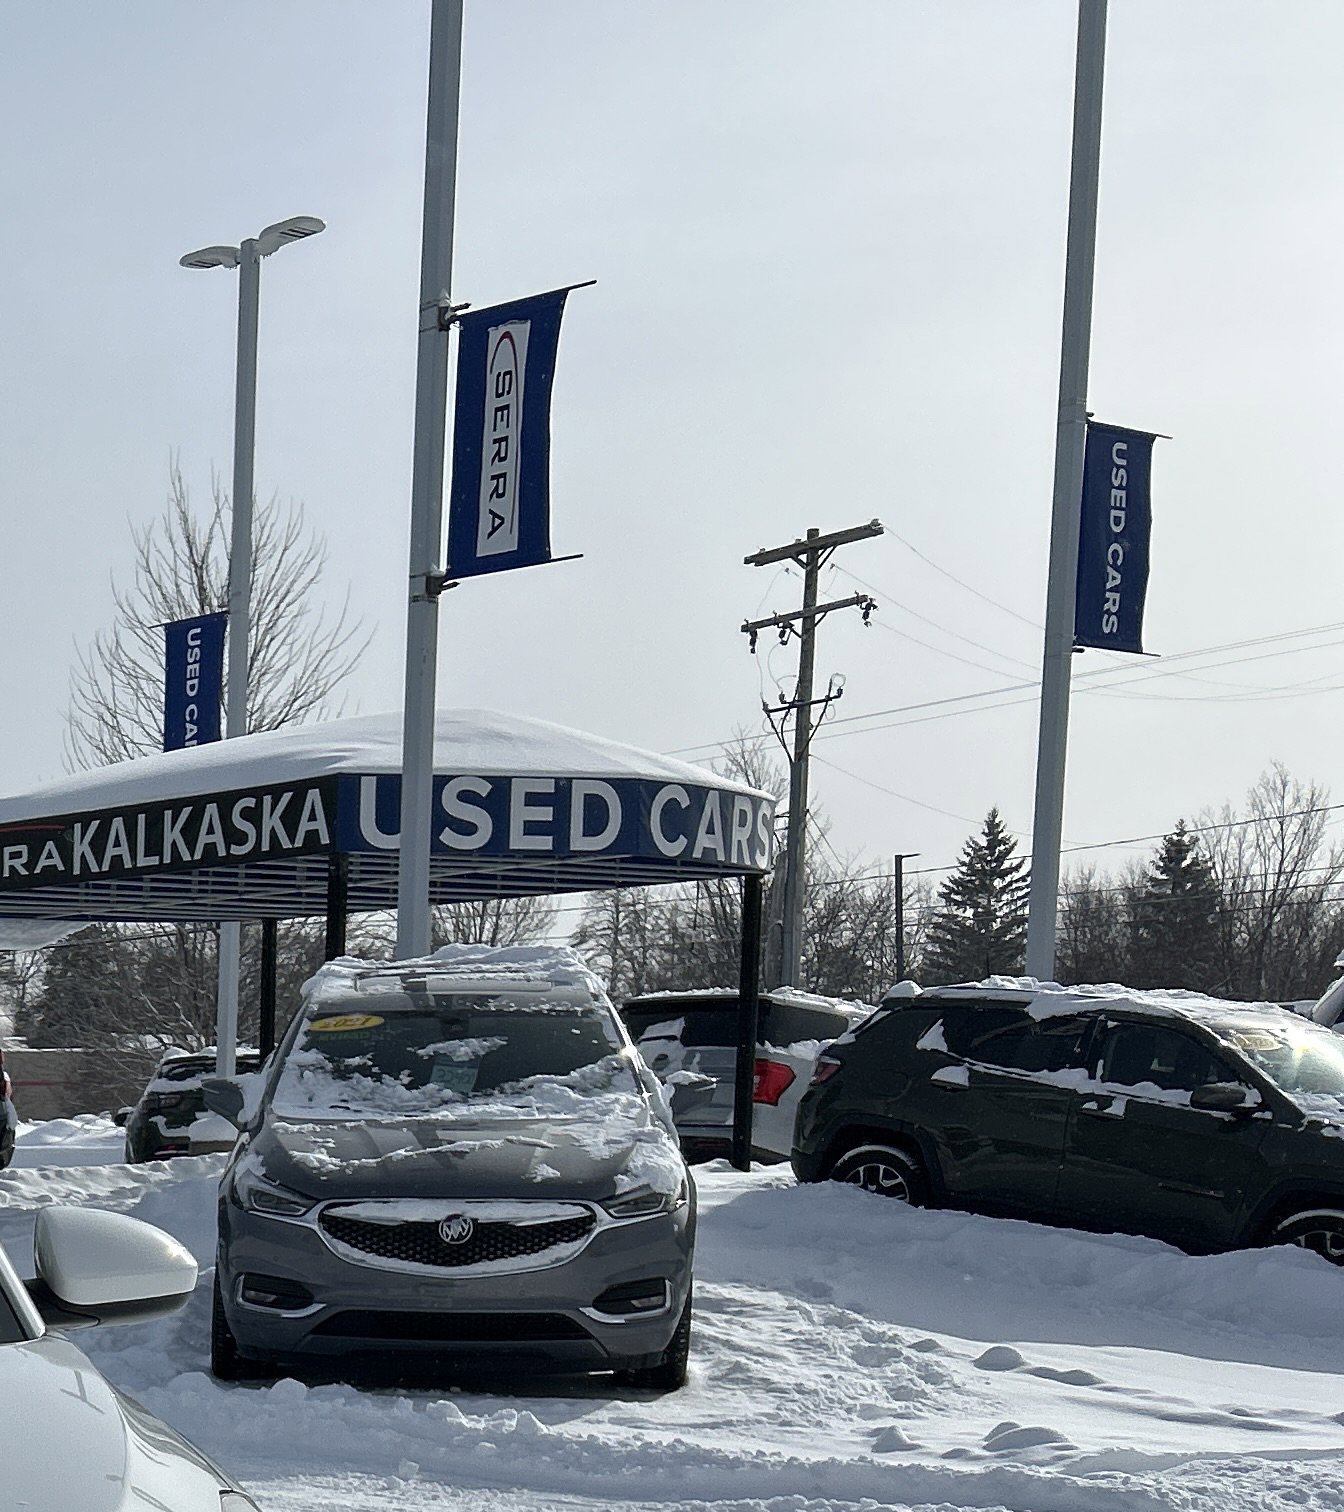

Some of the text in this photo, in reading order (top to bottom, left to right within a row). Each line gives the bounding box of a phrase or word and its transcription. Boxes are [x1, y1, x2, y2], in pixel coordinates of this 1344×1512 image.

[486, 369, 513, 541] SERRA
[1101, 441, 1128, 635] USED CARS
[185, 626, 202, 698] USED
[71, 788, 331, 876] KALKASKA
[358, 775, 774, 871] USED CARS
